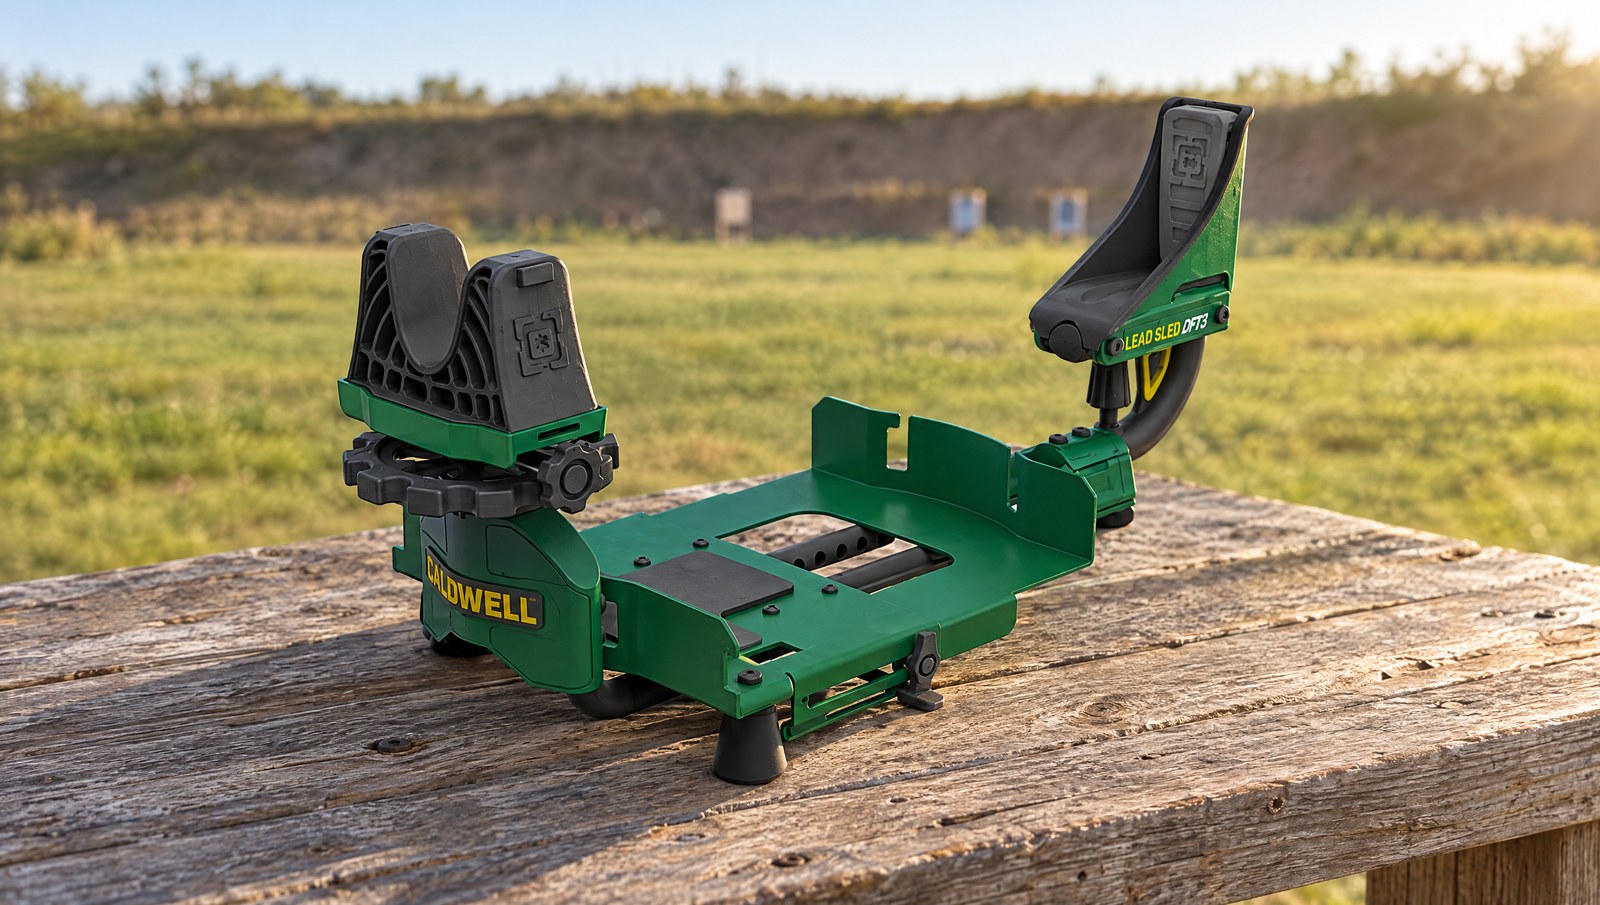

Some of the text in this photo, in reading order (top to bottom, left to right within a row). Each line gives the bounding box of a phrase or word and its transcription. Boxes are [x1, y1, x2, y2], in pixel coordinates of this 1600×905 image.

[1125, 312, 1209, 351] LEAD SLED DFT3
[426, 555, 537, 625] CALDWELL
